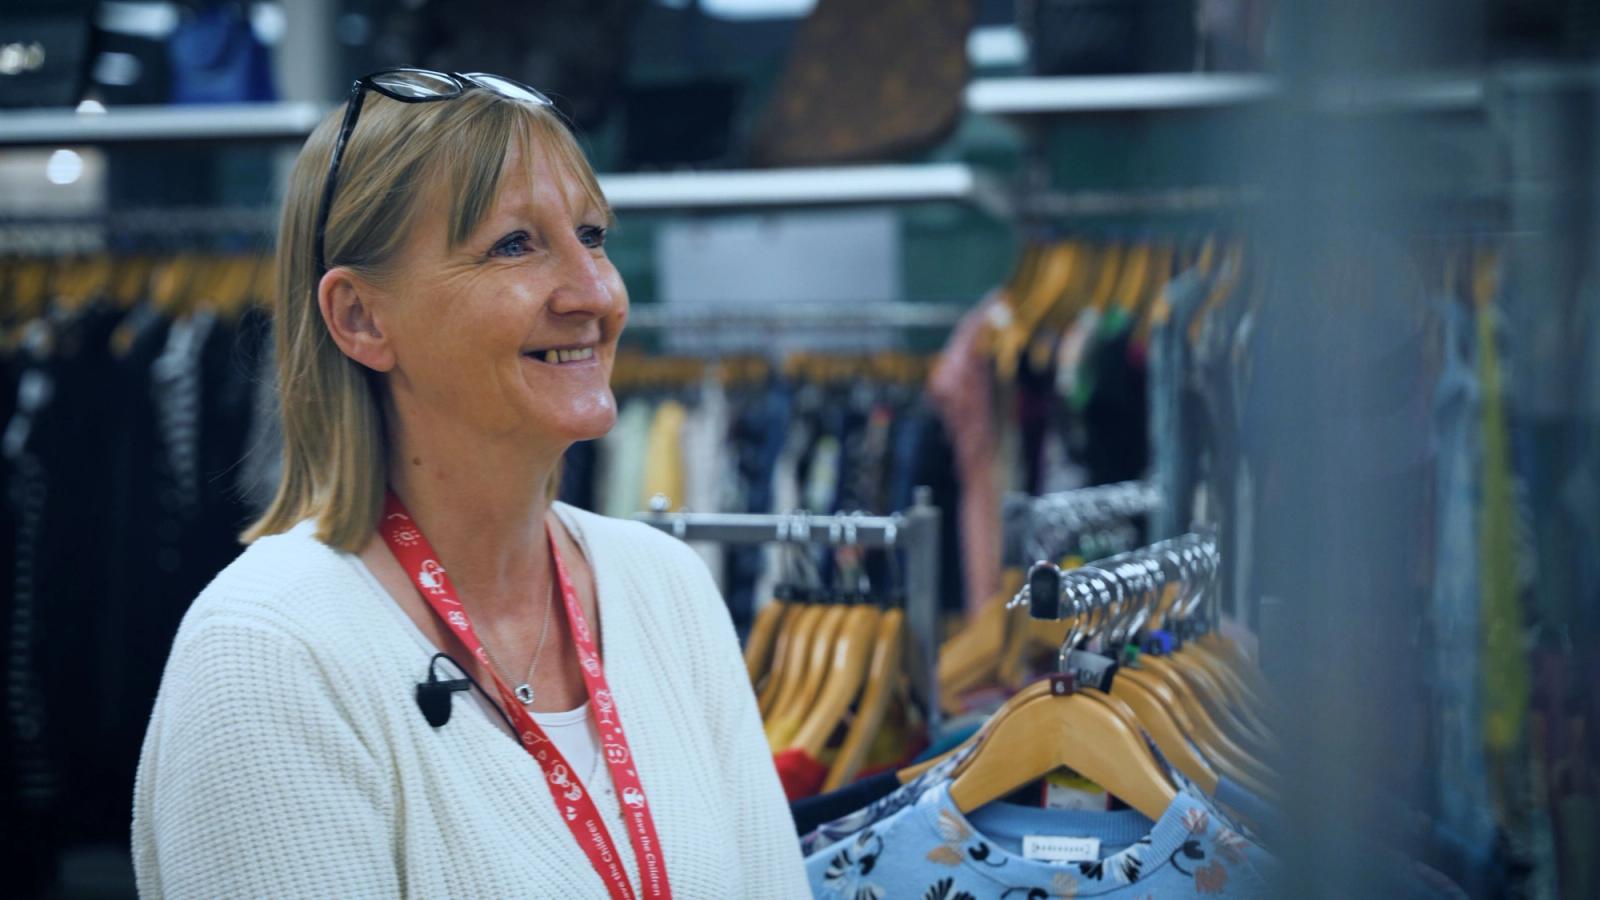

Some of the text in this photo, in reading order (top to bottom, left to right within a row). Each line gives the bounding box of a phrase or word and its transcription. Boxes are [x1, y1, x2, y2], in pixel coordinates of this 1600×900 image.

[584, 819, 632, 900] ave the Children
[633, 812, 661, 896] Save the Children
